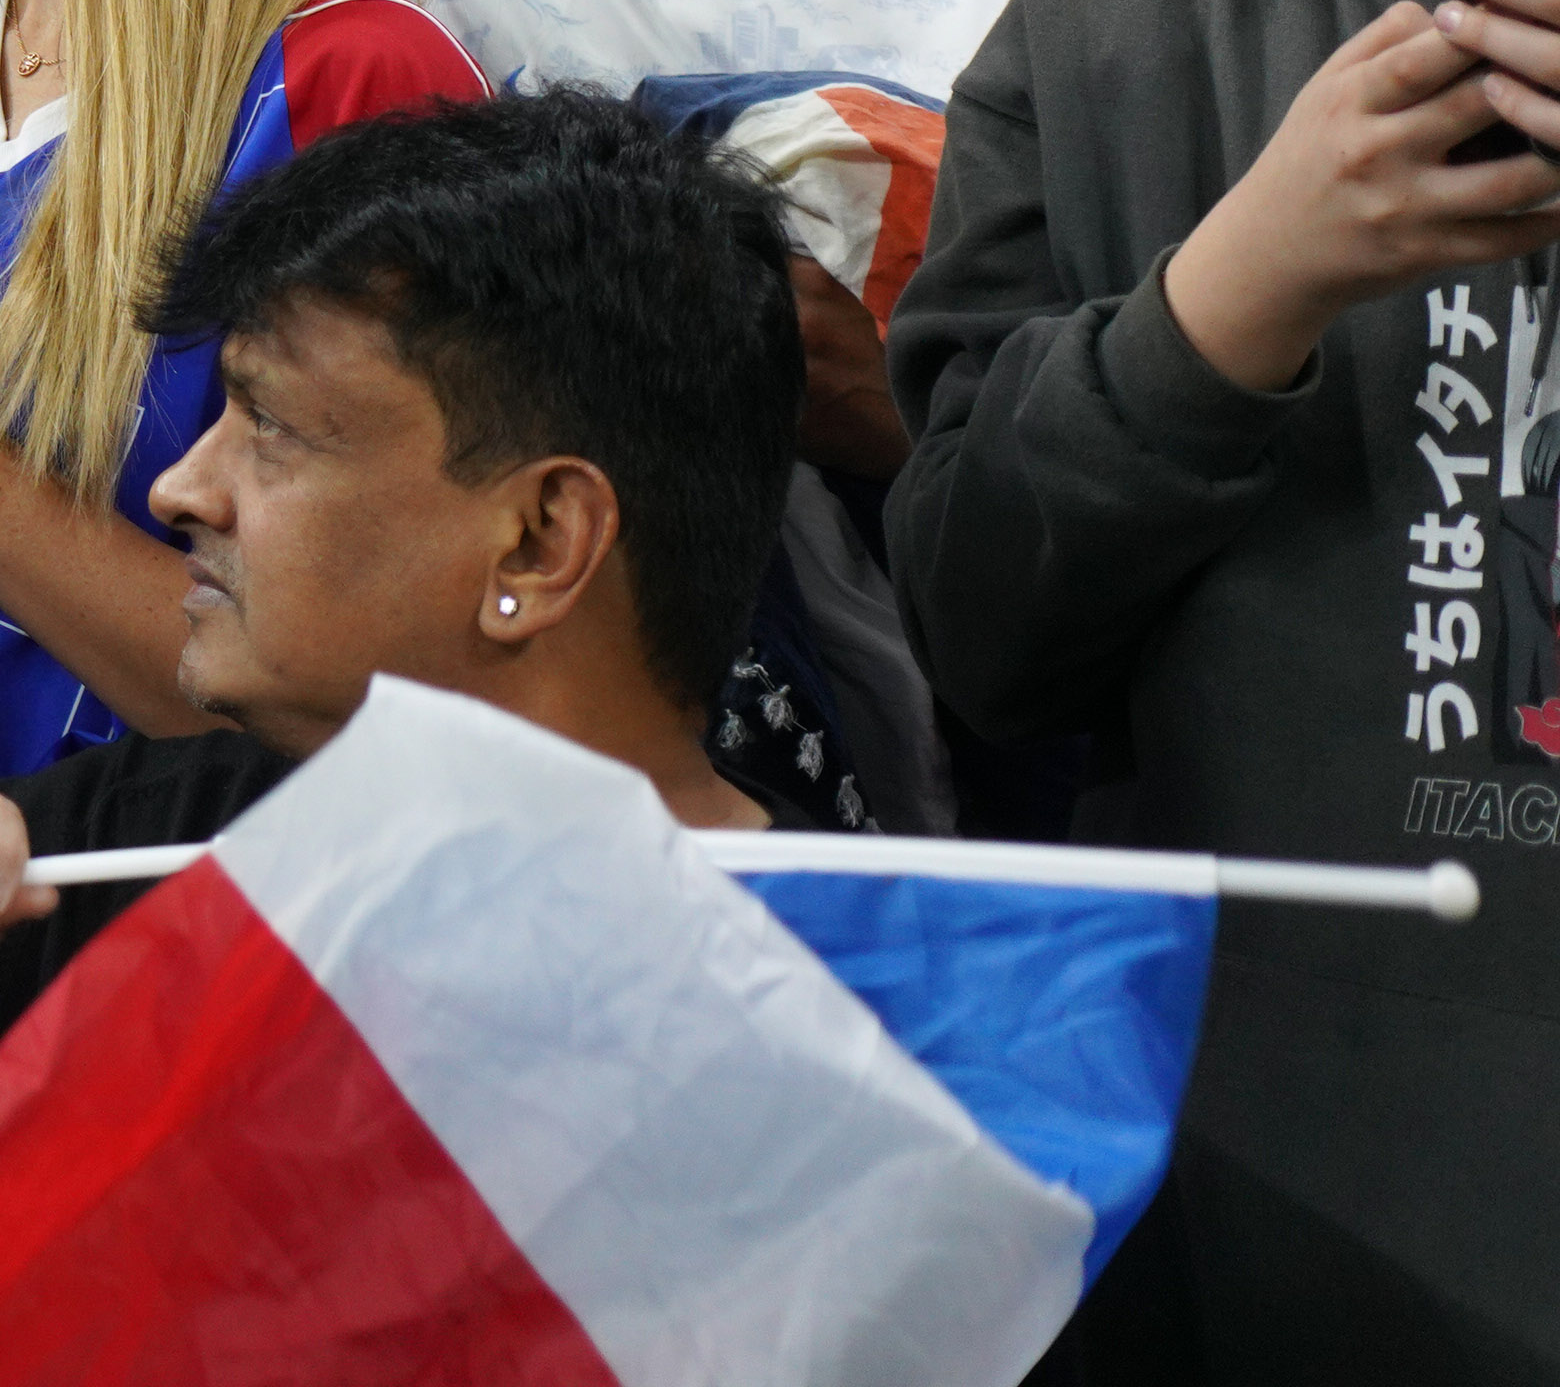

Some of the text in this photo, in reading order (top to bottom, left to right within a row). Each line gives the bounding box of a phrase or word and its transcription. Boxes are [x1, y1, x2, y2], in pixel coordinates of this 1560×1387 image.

[1405, 284, 1498, 753] うちはイタチ
[1403, 777, 1560, 845] ITAC
